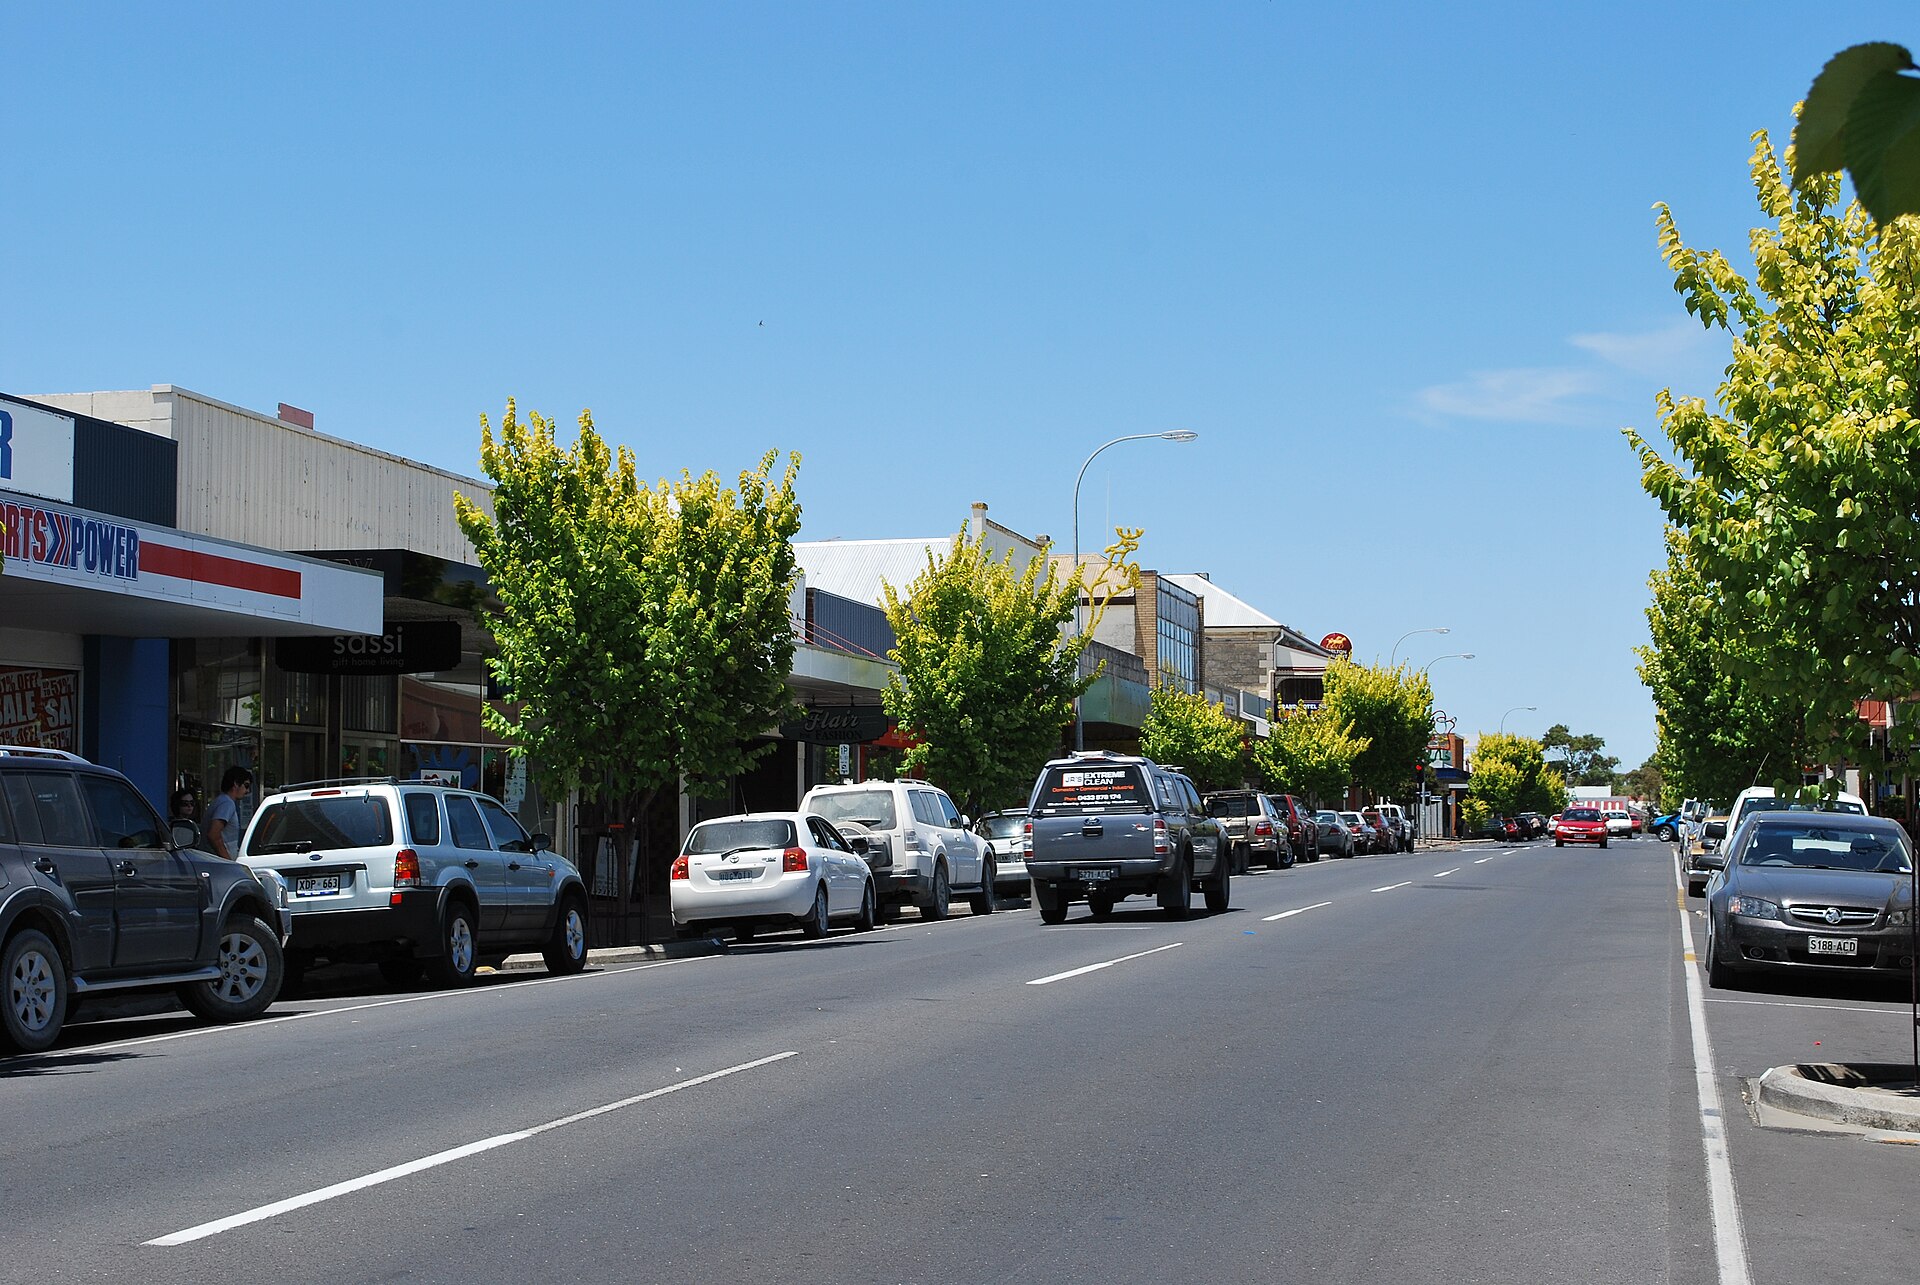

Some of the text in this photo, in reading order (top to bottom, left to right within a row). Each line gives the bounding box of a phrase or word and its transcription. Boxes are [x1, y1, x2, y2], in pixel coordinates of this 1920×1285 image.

[70, 515, 139, 581] POWER
[333, 626, 403, 655] sassi
[332, 656, 405, 669] gift home living
[0, 690, 38, 725] ALE
[804, 709, 860, 731] Flair
[815, 729, 863, 740] FASHION
[1065, 775, 1083, 783] JR'S
[1084, 771, 1125, 779] EXTREME
[1084, 778, 1114, 786] CLEAN
[299, 878, 338, 890] XDP 663
